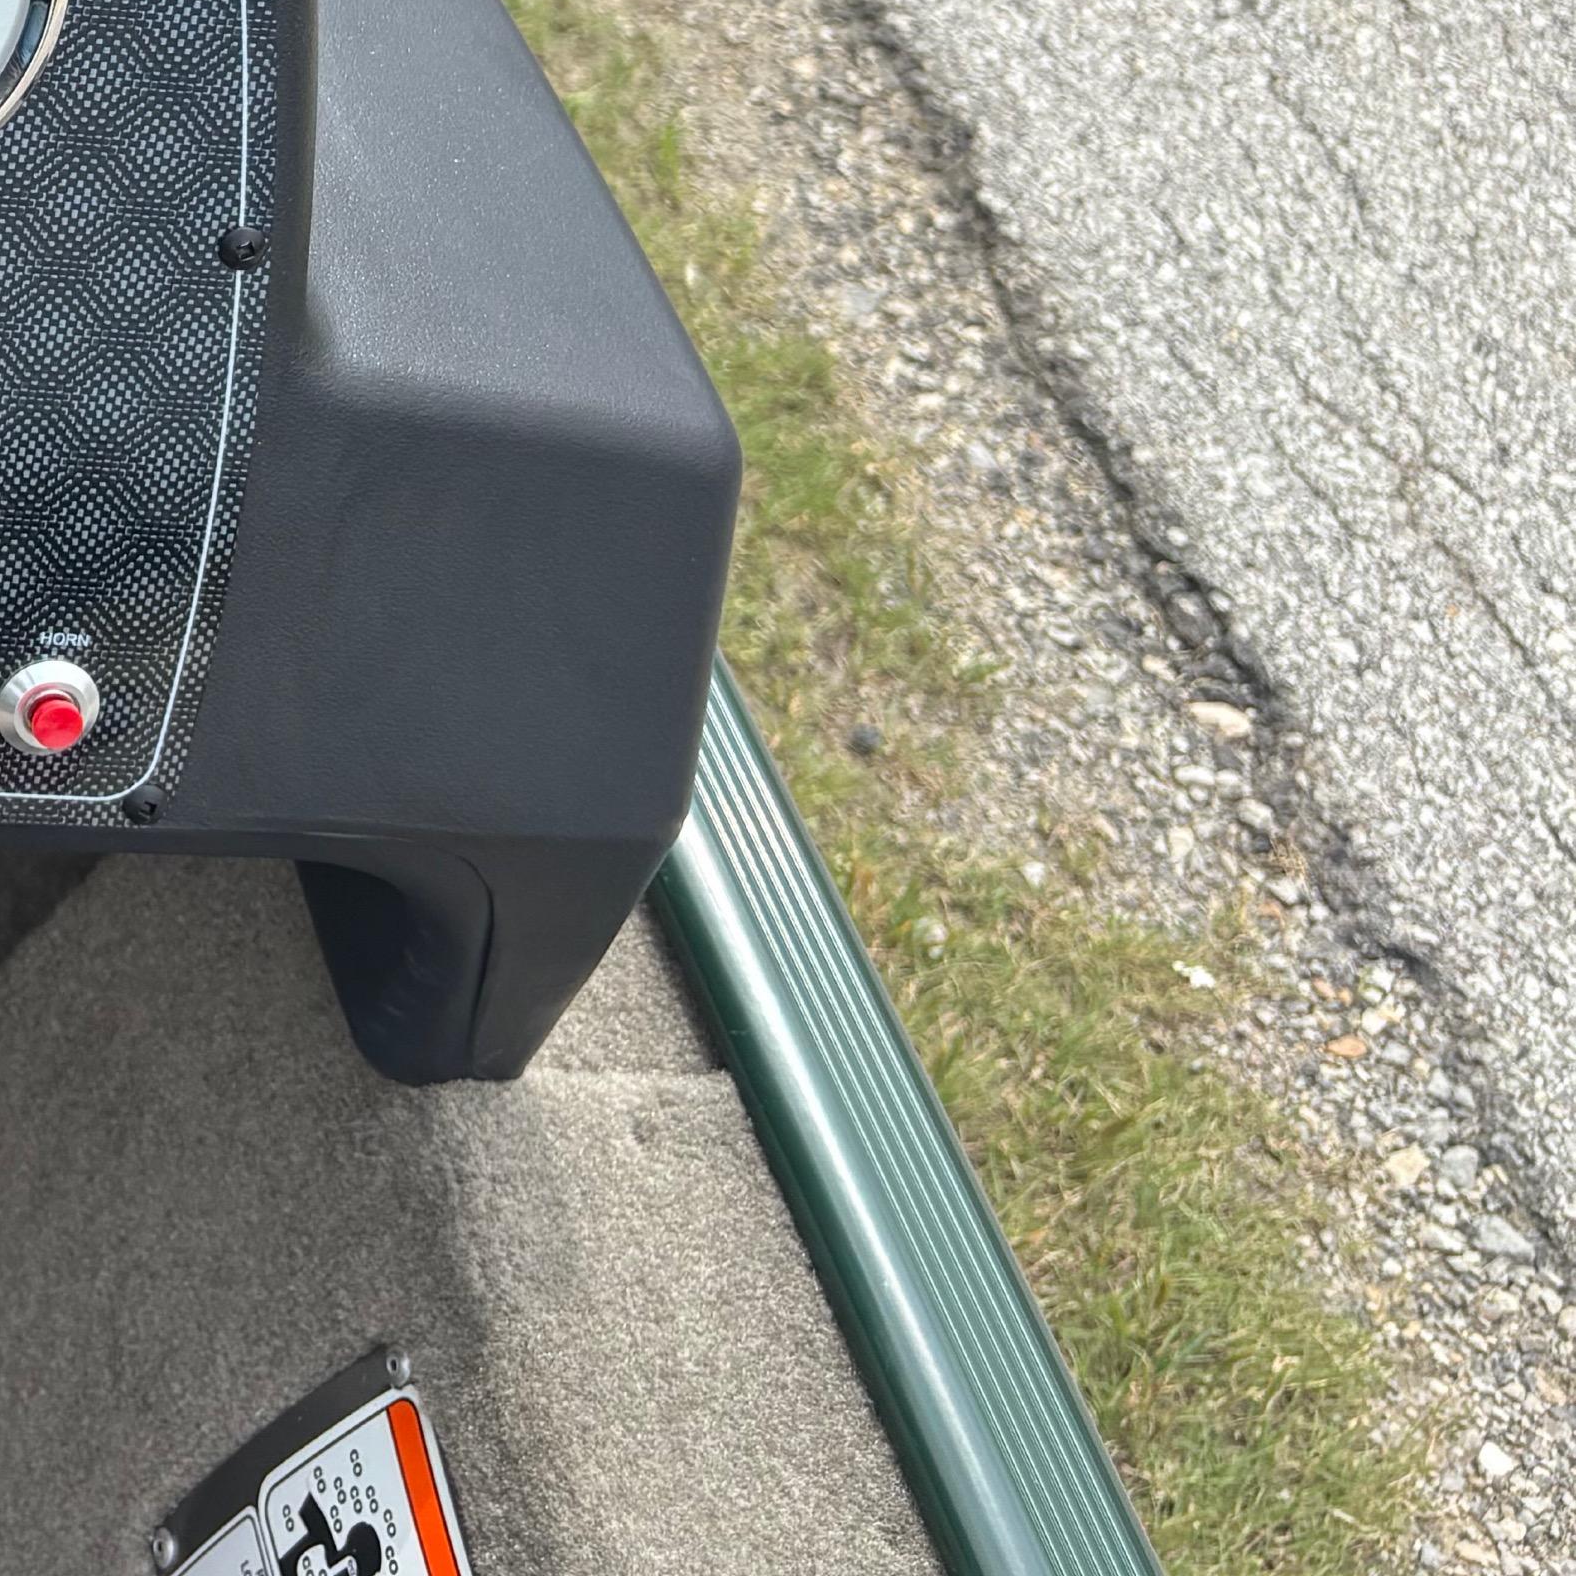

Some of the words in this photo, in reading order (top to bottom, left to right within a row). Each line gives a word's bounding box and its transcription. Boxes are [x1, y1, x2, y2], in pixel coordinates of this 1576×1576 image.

[39, 631, 92, 648] HORN
[349, 1448, 363, 1477] CO
[312, 1465, 327, 1494] CO
[333, 1476, 347, 1505] CO
[350, 1485, 363, 1514] CO
[365, 1485, 379, 1514] CO
[282, 1504, 295, 1533] CO
[330, 1504, 343, 1534] CO
[383, 1508, 396, 1539] CO
[385, 1545, 399, 1575] CO
